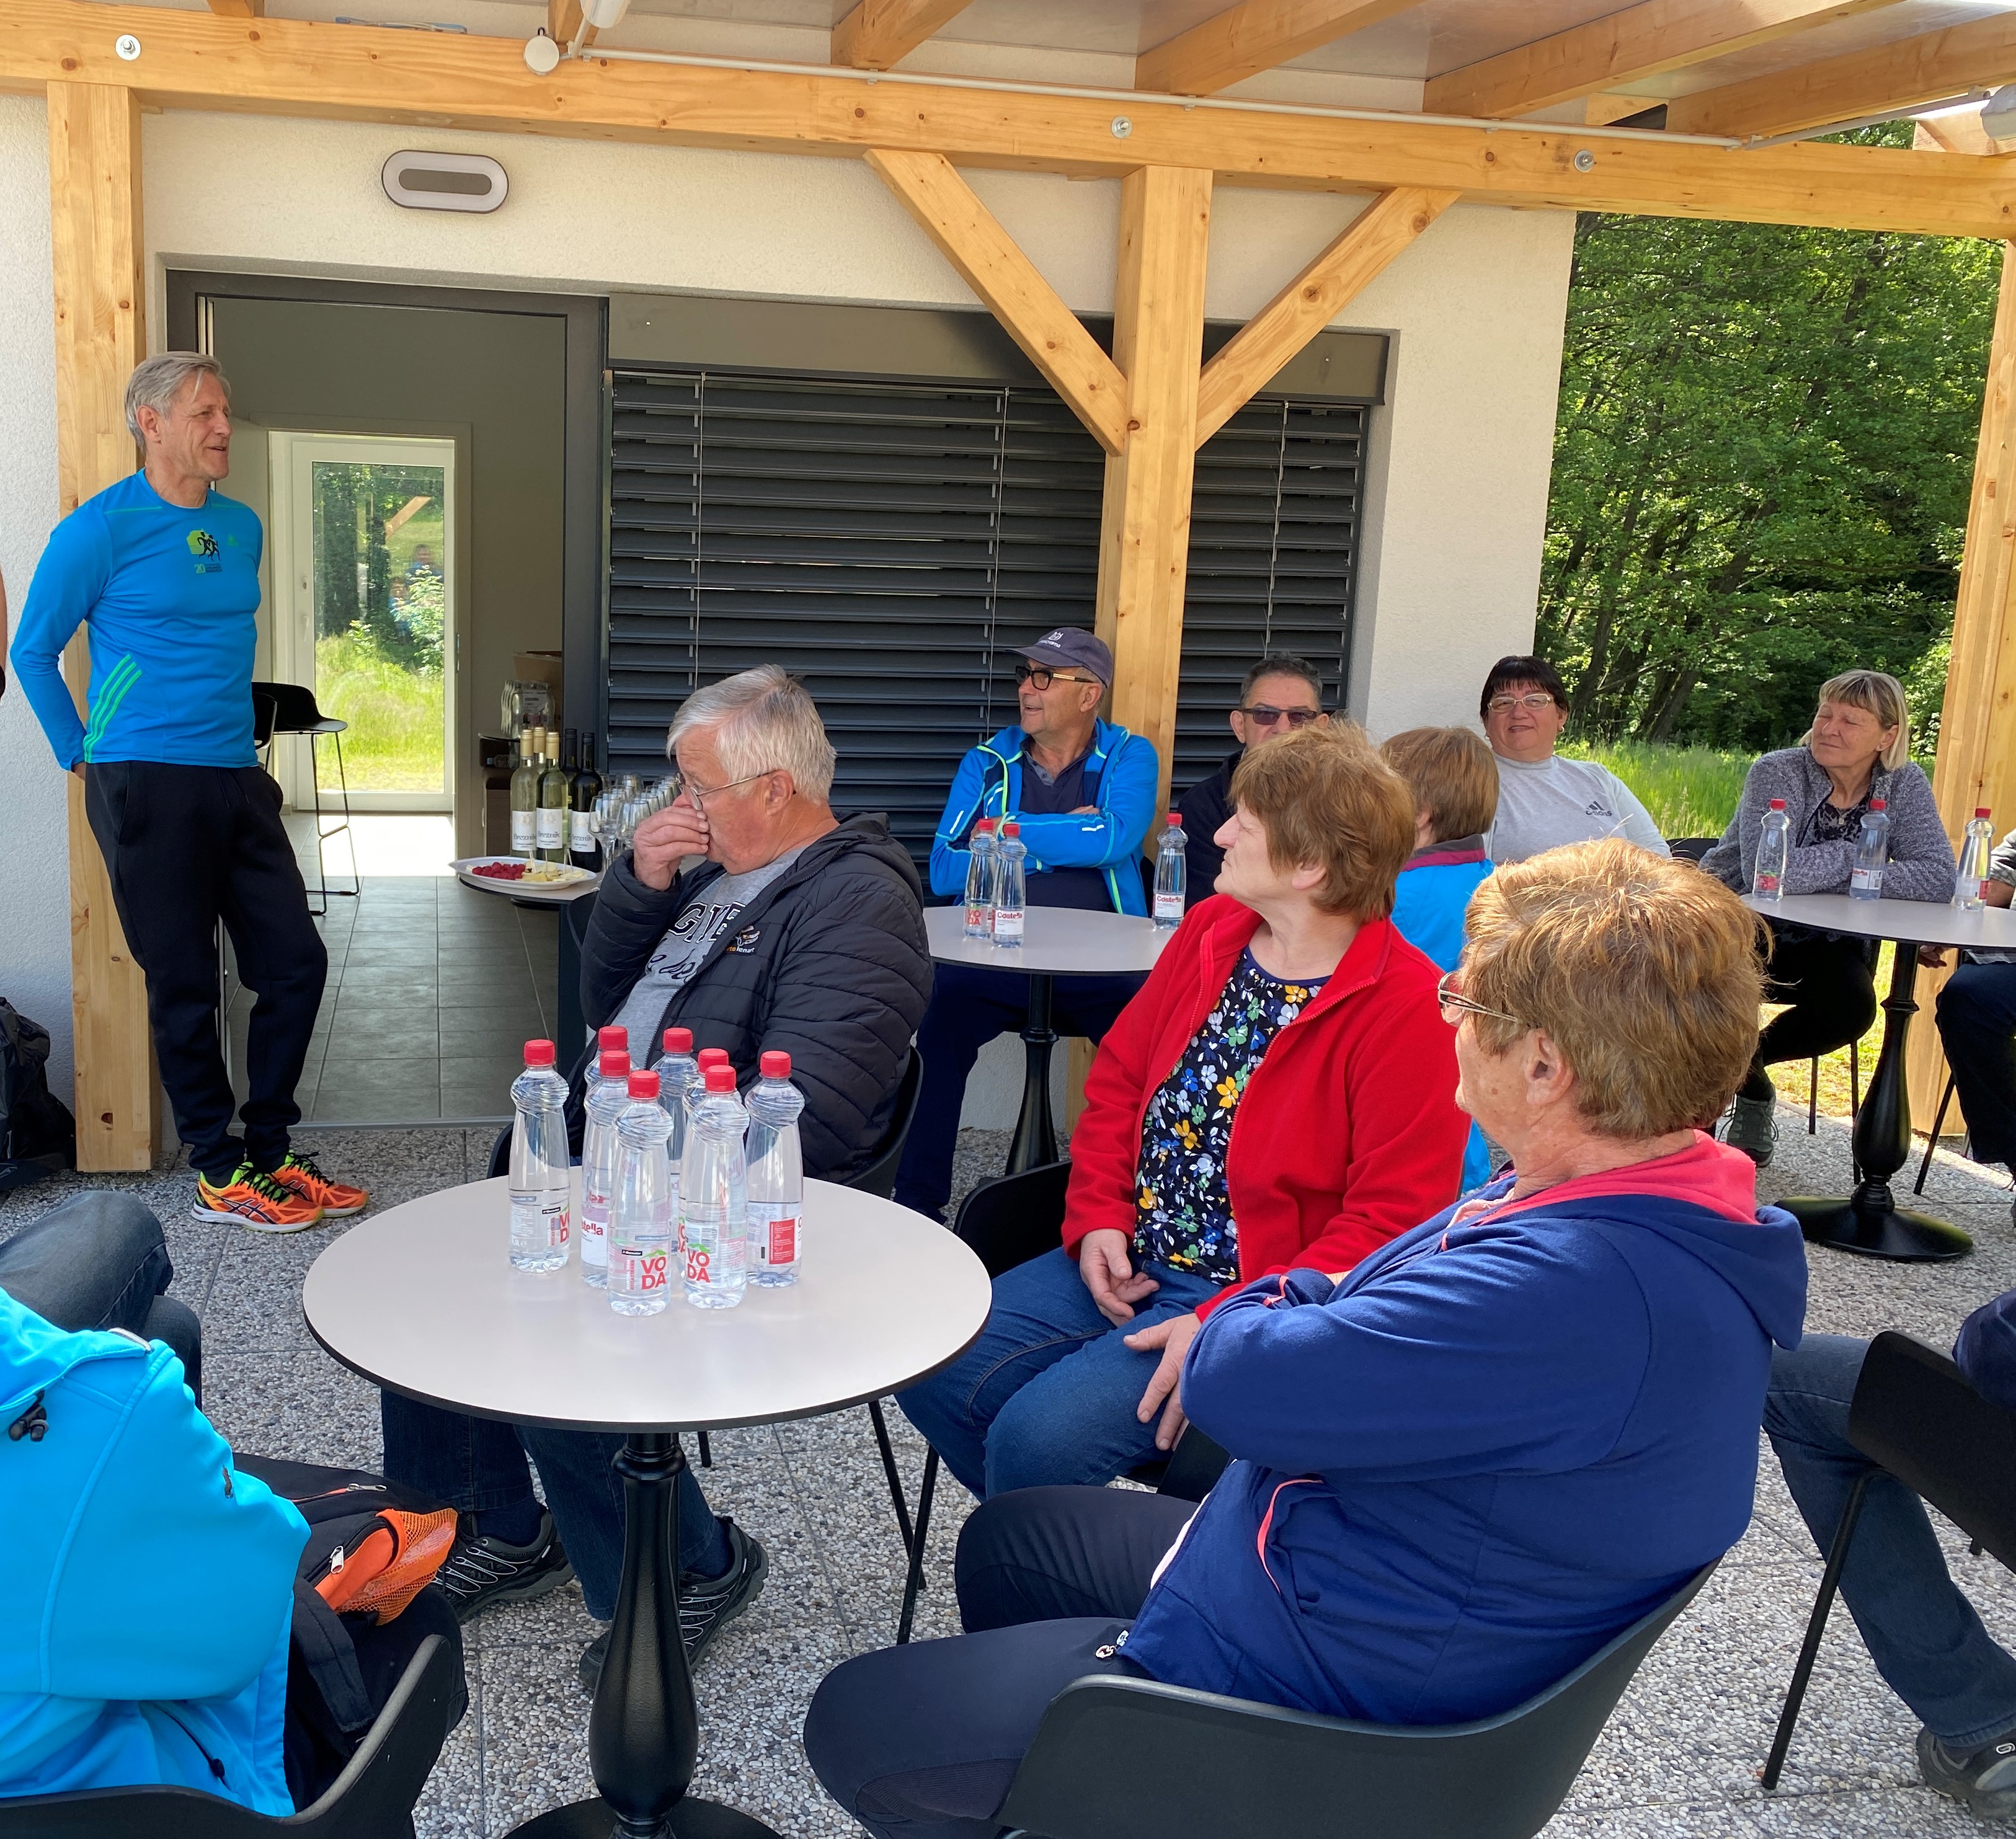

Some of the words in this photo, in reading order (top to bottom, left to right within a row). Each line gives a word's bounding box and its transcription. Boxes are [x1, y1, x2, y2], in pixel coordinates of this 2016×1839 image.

[641, 1256, 666, 1274] VO
[686, 1247, 710, 1267] VO
[641, 1271, 666, 1290] DA
[686, 1263, 711, 1283] DA
